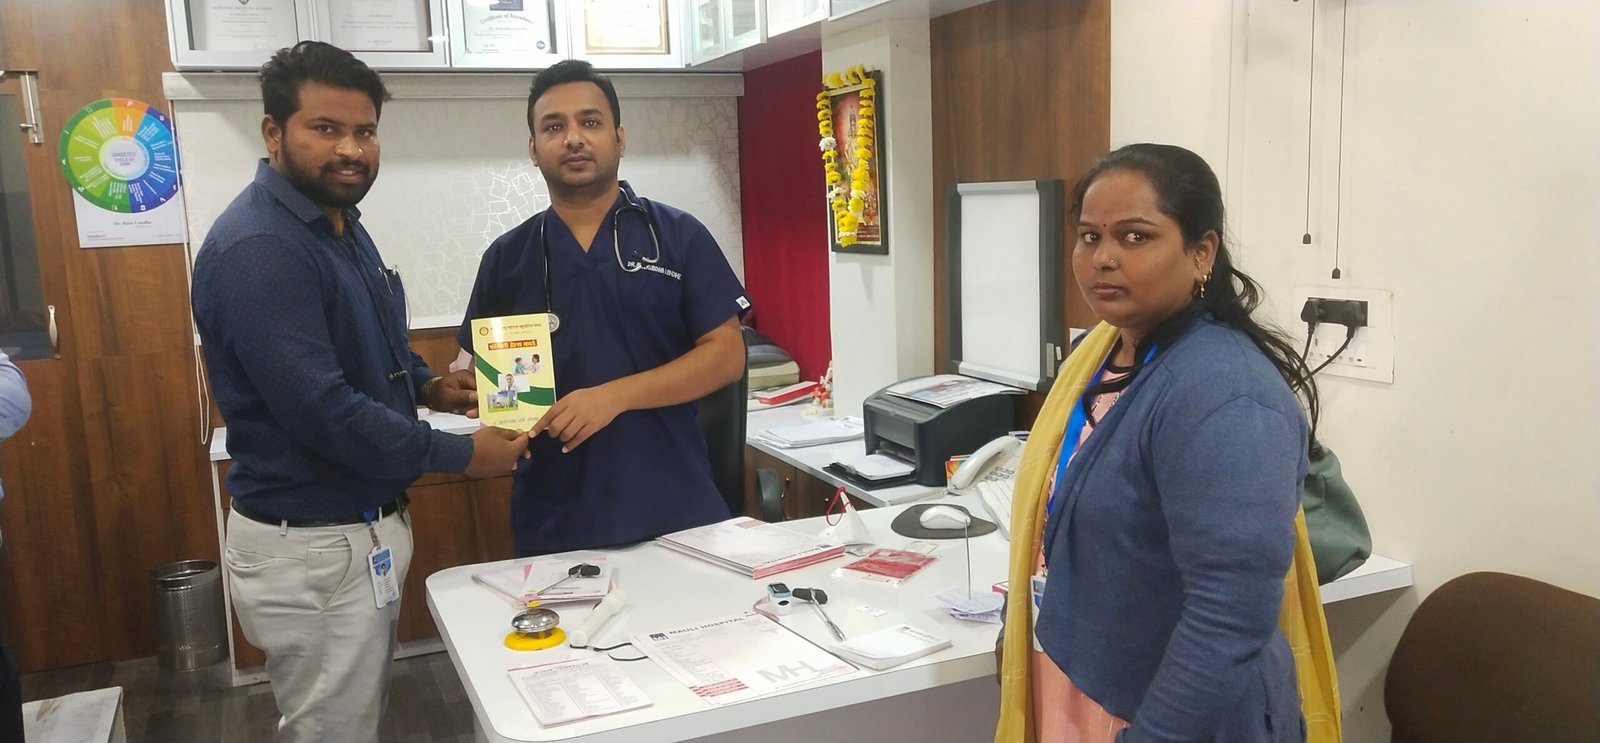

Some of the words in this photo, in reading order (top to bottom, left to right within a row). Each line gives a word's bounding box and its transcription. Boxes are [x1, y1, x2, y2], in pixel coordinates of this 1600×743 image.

[669, 626, 699, 635] MAULI
[700, 617, 745, 630] HOSPITAL
[756, 660, 820, 684] MH
